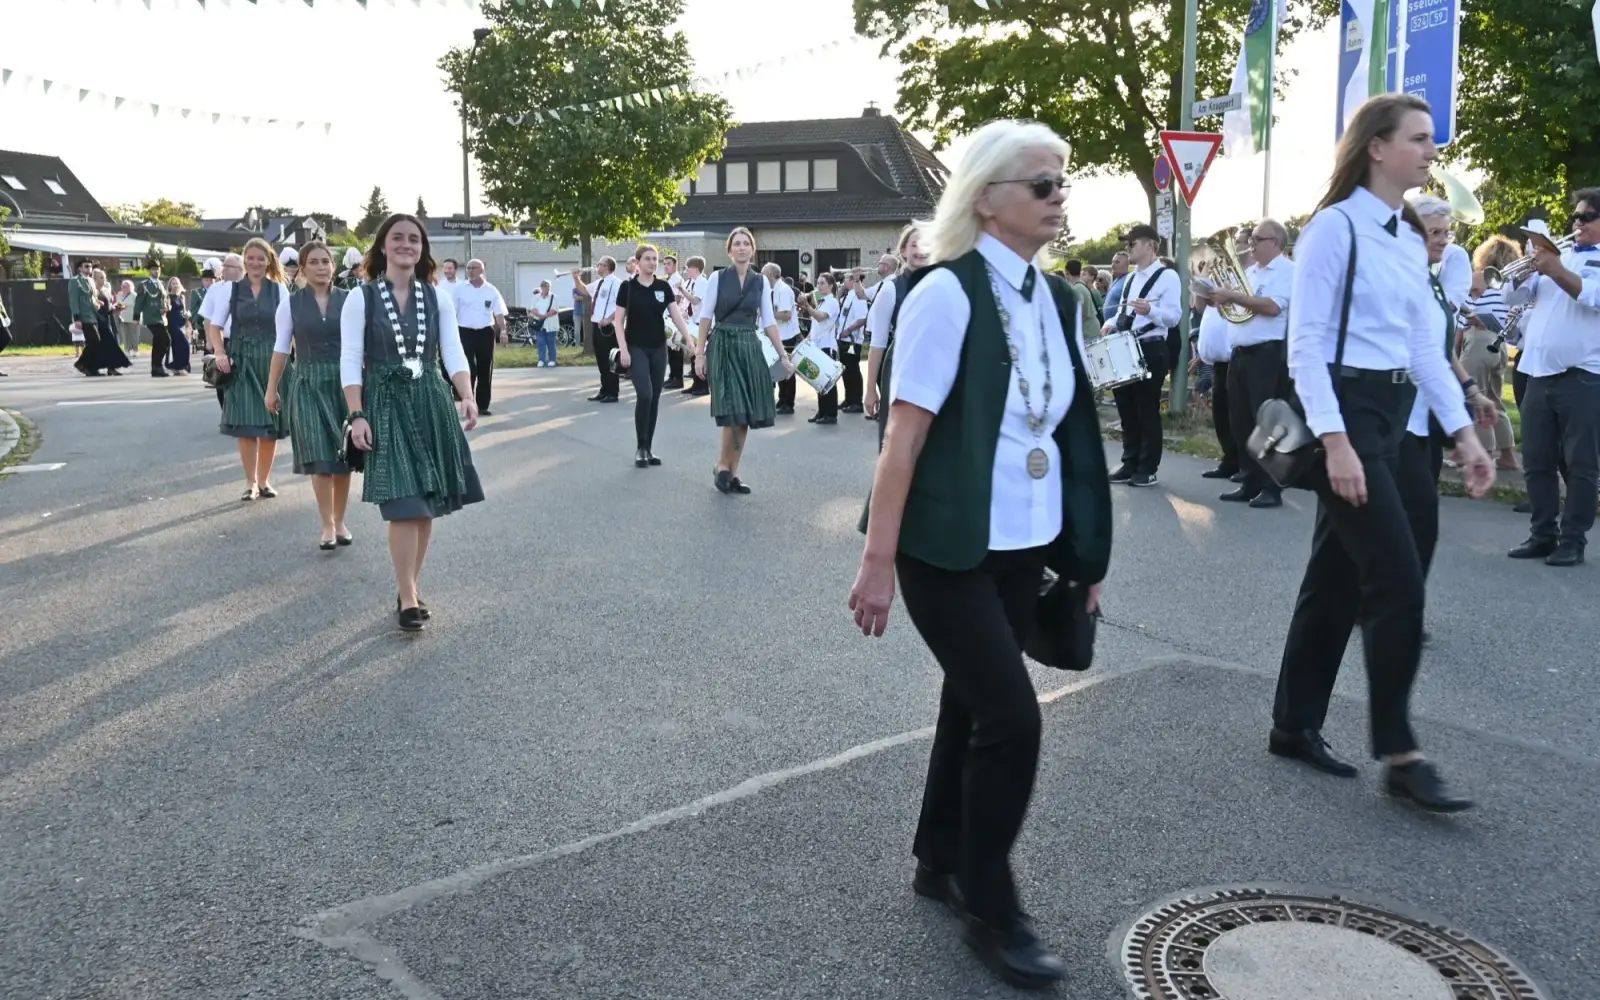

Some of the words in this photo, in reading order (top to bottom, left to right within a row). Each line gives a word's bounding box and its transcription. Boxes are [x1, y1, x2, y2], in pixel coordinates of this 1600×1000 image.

[1404, 73, 1427, 86] ssen
[1198, 104, 1207, 114] Am
[1209, 98, 1234, 113] Knappert
